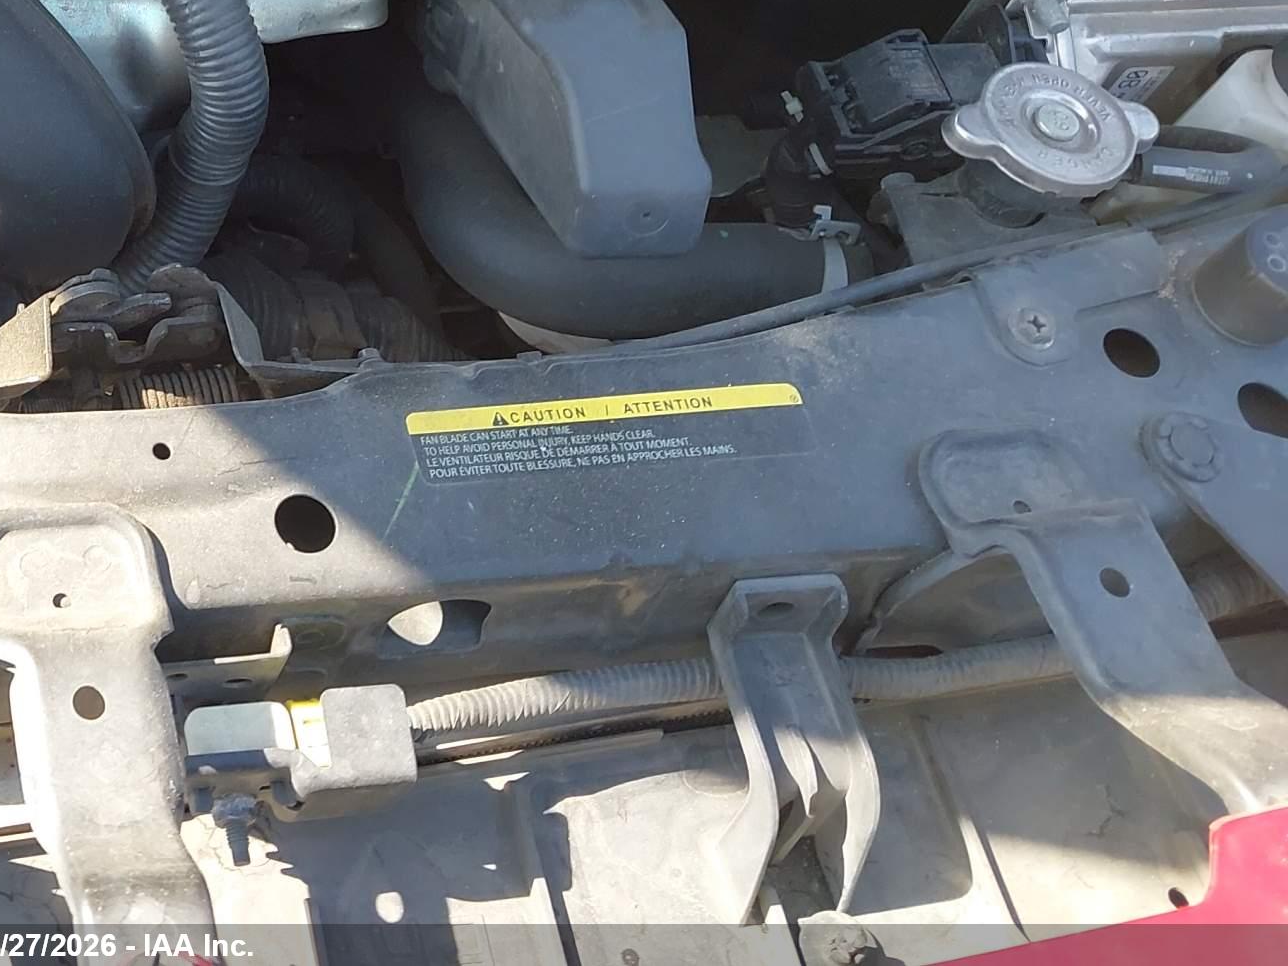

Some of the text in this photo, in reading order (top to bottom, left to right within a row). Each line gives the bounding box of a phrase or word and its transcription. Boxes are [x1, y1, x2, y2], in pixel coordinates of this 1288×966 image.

[509, 408, 586, 423] CAUTION
[623, 396, 713, 414] ATTENTION
[420, 435, 440, 447] FAN
[439, 433, 469, 445] BLADE
[470, 431, 490, 442] CAN
[491, 428, 517, 440] START
[530, 426, 549, 436] ANY
[438, 444, 461, 456] HELP
[462, 442, 491, 454] AVOID
[491, 438, 538, 451] PERSONAL
[570, 434, 593, 445] KEEP
[593, 431, 625, 443] HANDS
[625, 428, 656, 440] CLEAR.
[429, 467, 459, 479] POUR
[492, 461, 525, 474] TOUTE
[592, 455, 611, 466] PAS
[626, 448, 685, 463] APPROCHER
[684, 446, 703, 458] LES
[702, 443, 737, 456] MAINS.
[439, 452, 505, 467] VENTILATEUR
[504, 448, 541, 461] RISQUE
[618, 440, 645, 452] TOUT
[645, 435, 693, 450] MOMENT.
